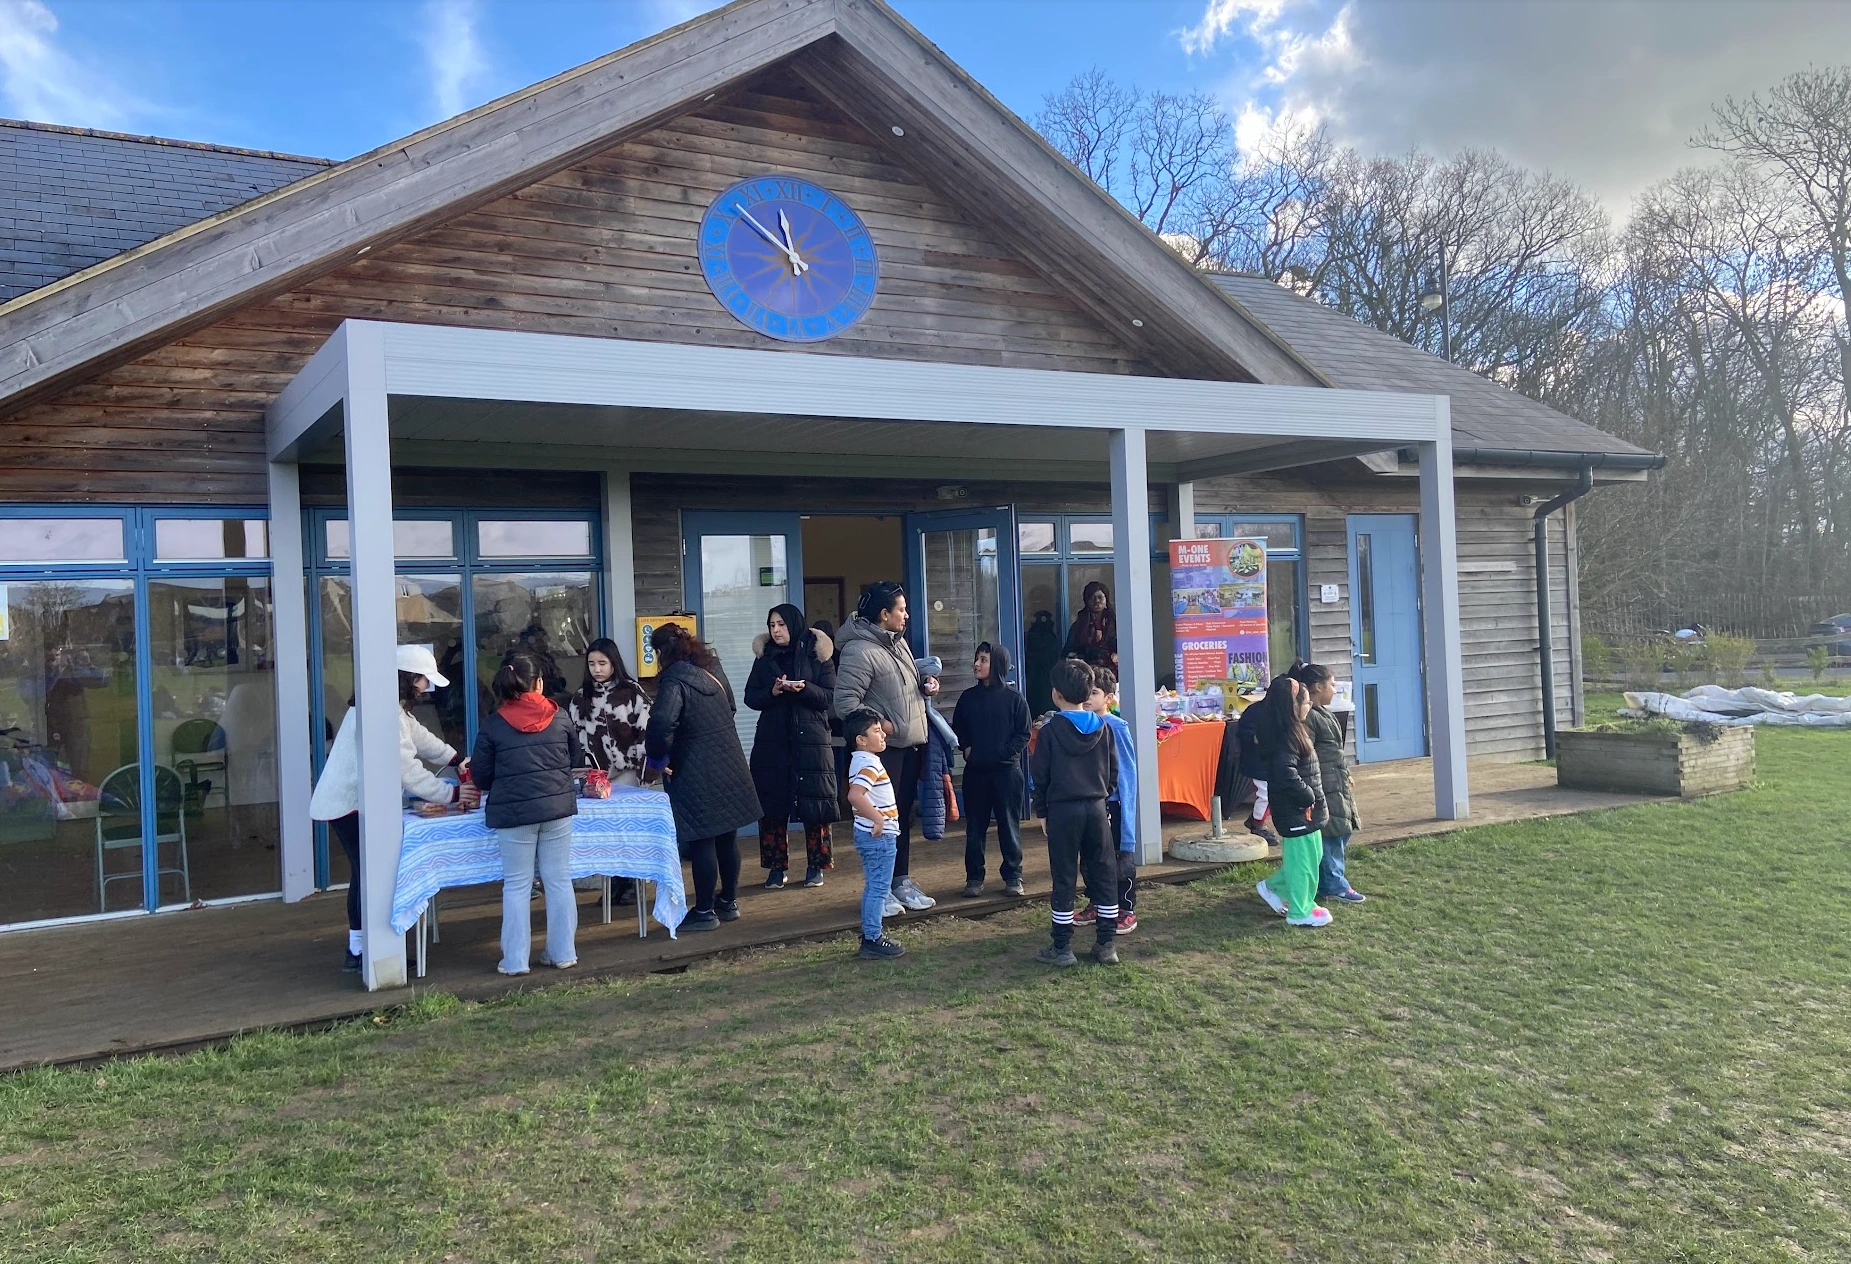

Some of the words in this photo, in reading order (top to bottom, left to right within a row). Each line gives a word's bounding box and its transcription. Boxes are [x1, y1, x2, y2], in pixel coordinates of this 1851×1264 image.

[739, 184, 765, 205] XI
[775, 180, 802, 200] XII
[844, 225, 863, 239] II
[705, 240, 726, 260] IX
[855, 257, 873, 275] III
[786, 317, 807, 336] VI
[826, 314, 842, 331] V
[1178, 544, 1209, 554] M-ONE
[1178, 554, 1211, 564] EVENTS
[1182, 641, 1228, 650] GROCERIES
[1175, 653, 1183, 680] STORE
[1229, 652, 1268, 664] FASHION
